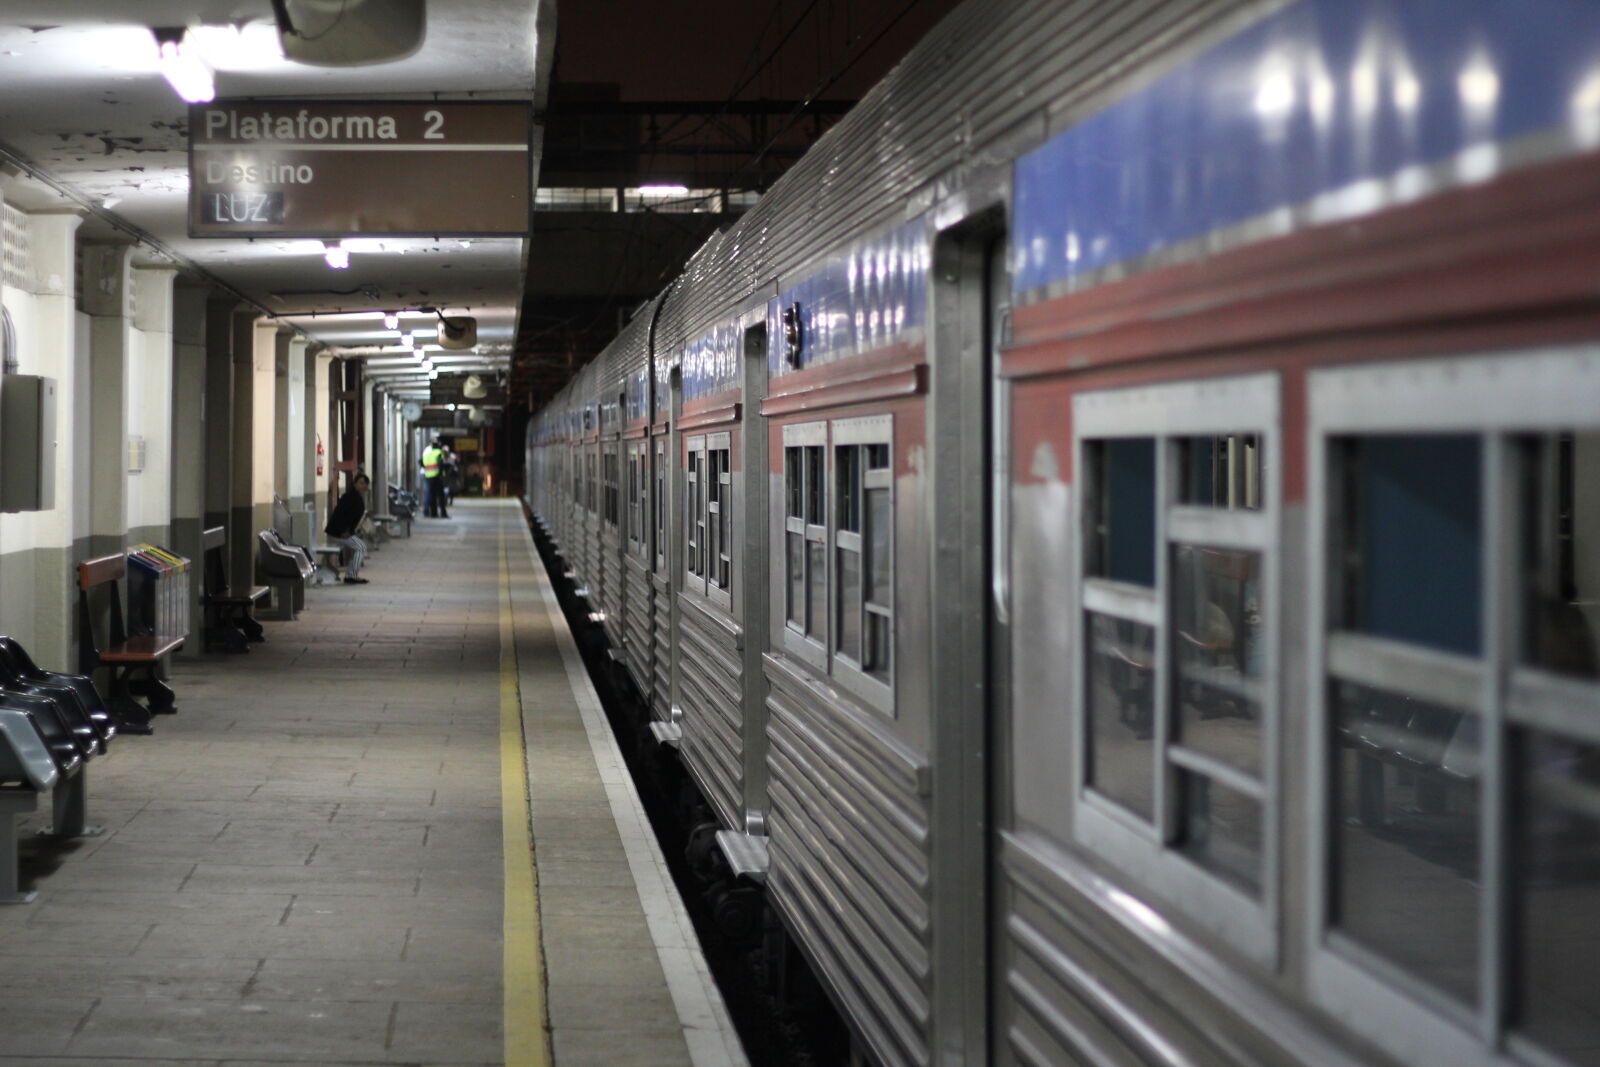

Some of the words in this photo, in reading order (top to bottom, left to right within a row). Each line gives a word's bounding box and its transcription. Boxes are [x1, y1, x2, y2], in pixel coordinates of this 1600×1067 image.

[205, 110, 397, 140] Plataforma
[423, 110, 445, 139] 2
[205, 160, 313, 184] Destino
[214, 193, 268, 222] LUZ
